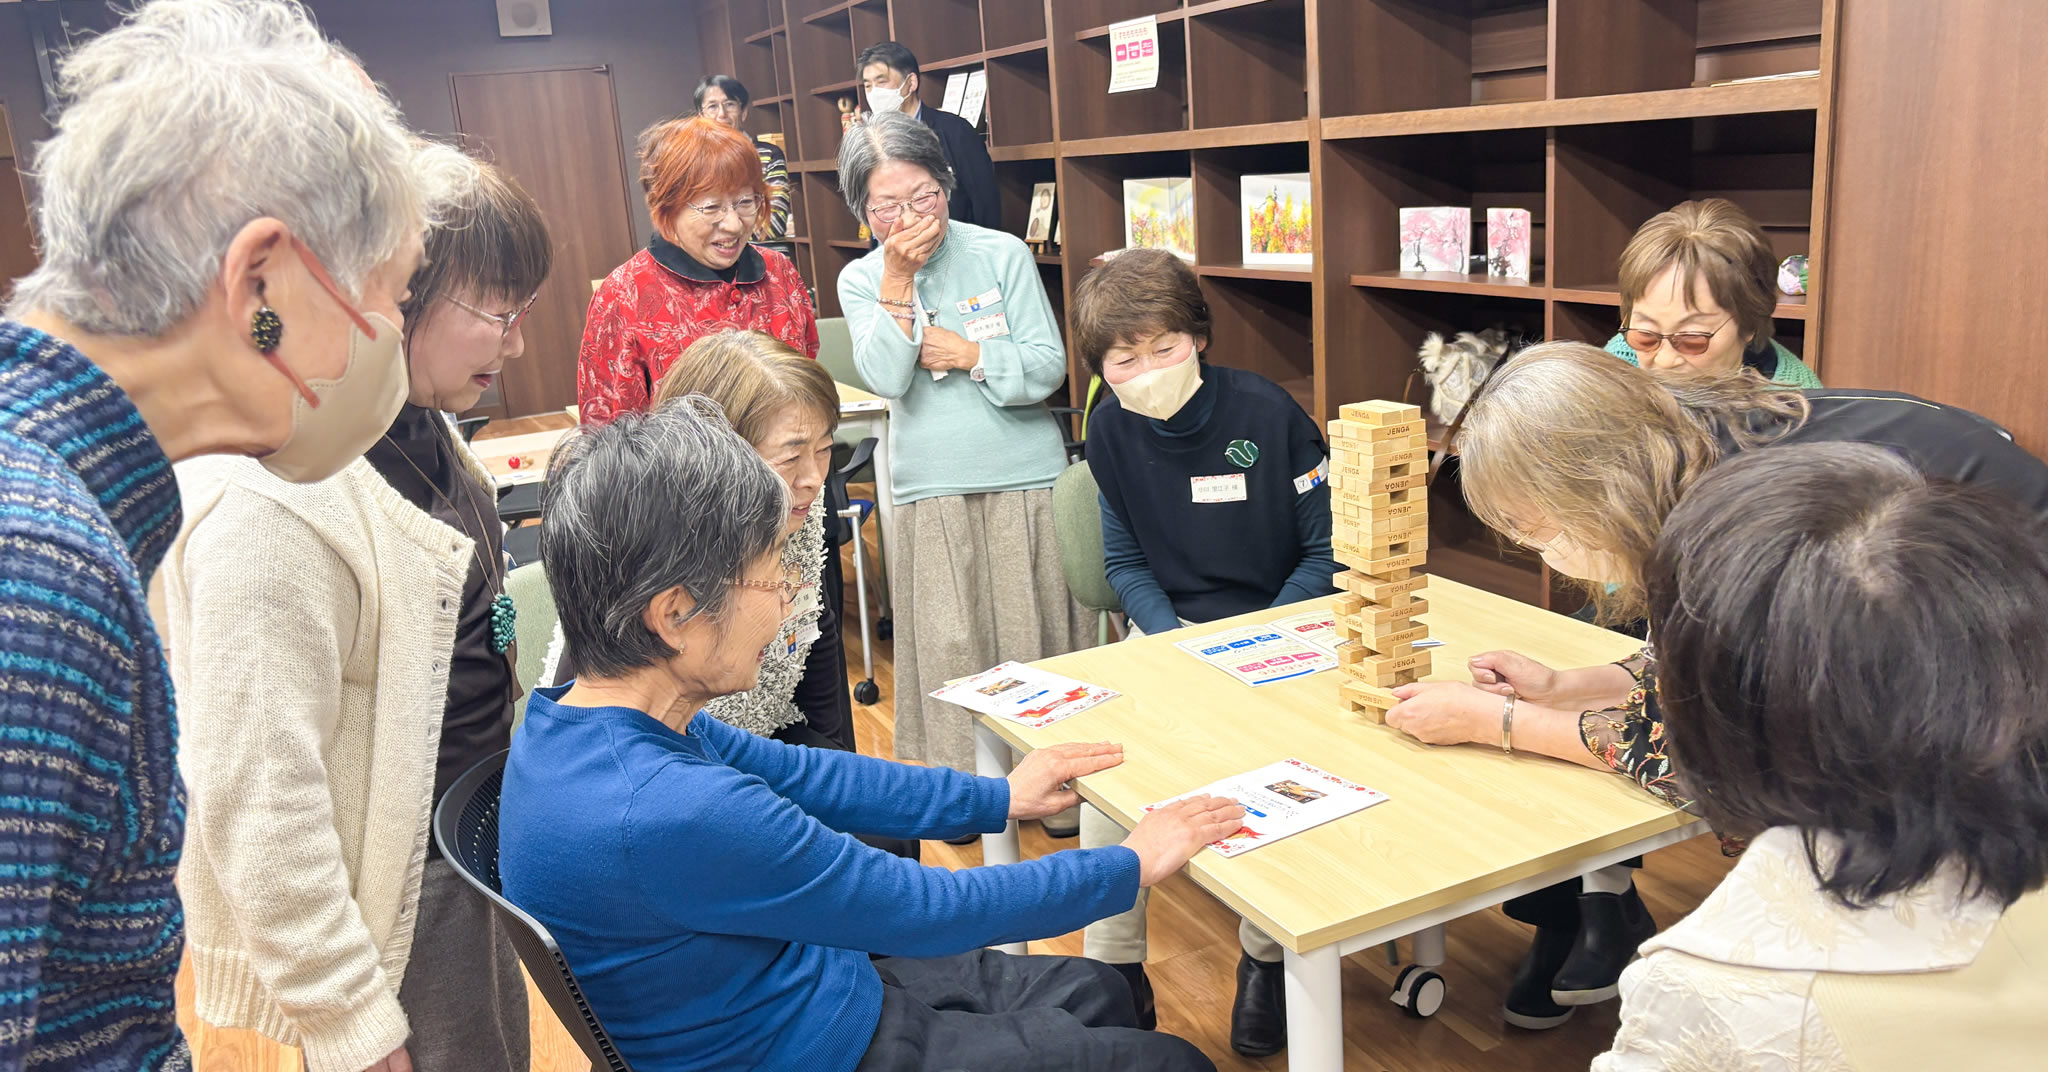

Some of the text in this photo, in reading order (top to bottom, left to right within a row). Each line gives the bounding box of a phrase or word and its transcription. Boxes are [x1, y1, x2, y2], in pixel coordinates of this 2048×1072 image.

[1351, 410, 1370, 419] JENGA
[1386, 425, 1410, 435] JENGA
[1389, 452, 1413, 462] JENGA
[1342, 466, 1360, 475] JENGA
[1385, 479, 1409, 490] JENGA
[1343, 492, 1360, 501] JENGA
[1388, 505, 1412, 515] JENGA
[1344, 519, 1360, 528] JENGA
[1387, 531, 1412, 542] JENGA
[1343, 543, 1360, 553] JENGA
[1386, 558, 1410, 569] JENGA
[1391, 582, 1413, 593] JENGA
[1390, 607, 1414, 617] JENGA
[1345, 618, 1363, 628] JENGA
[1391, 632, 1414, 642] JENGA
[1392, 657, 1416, 669] JENGA
[1349, 668, 1367, 680] JENGA
[1358, 694, 1383, 705] JENGA
